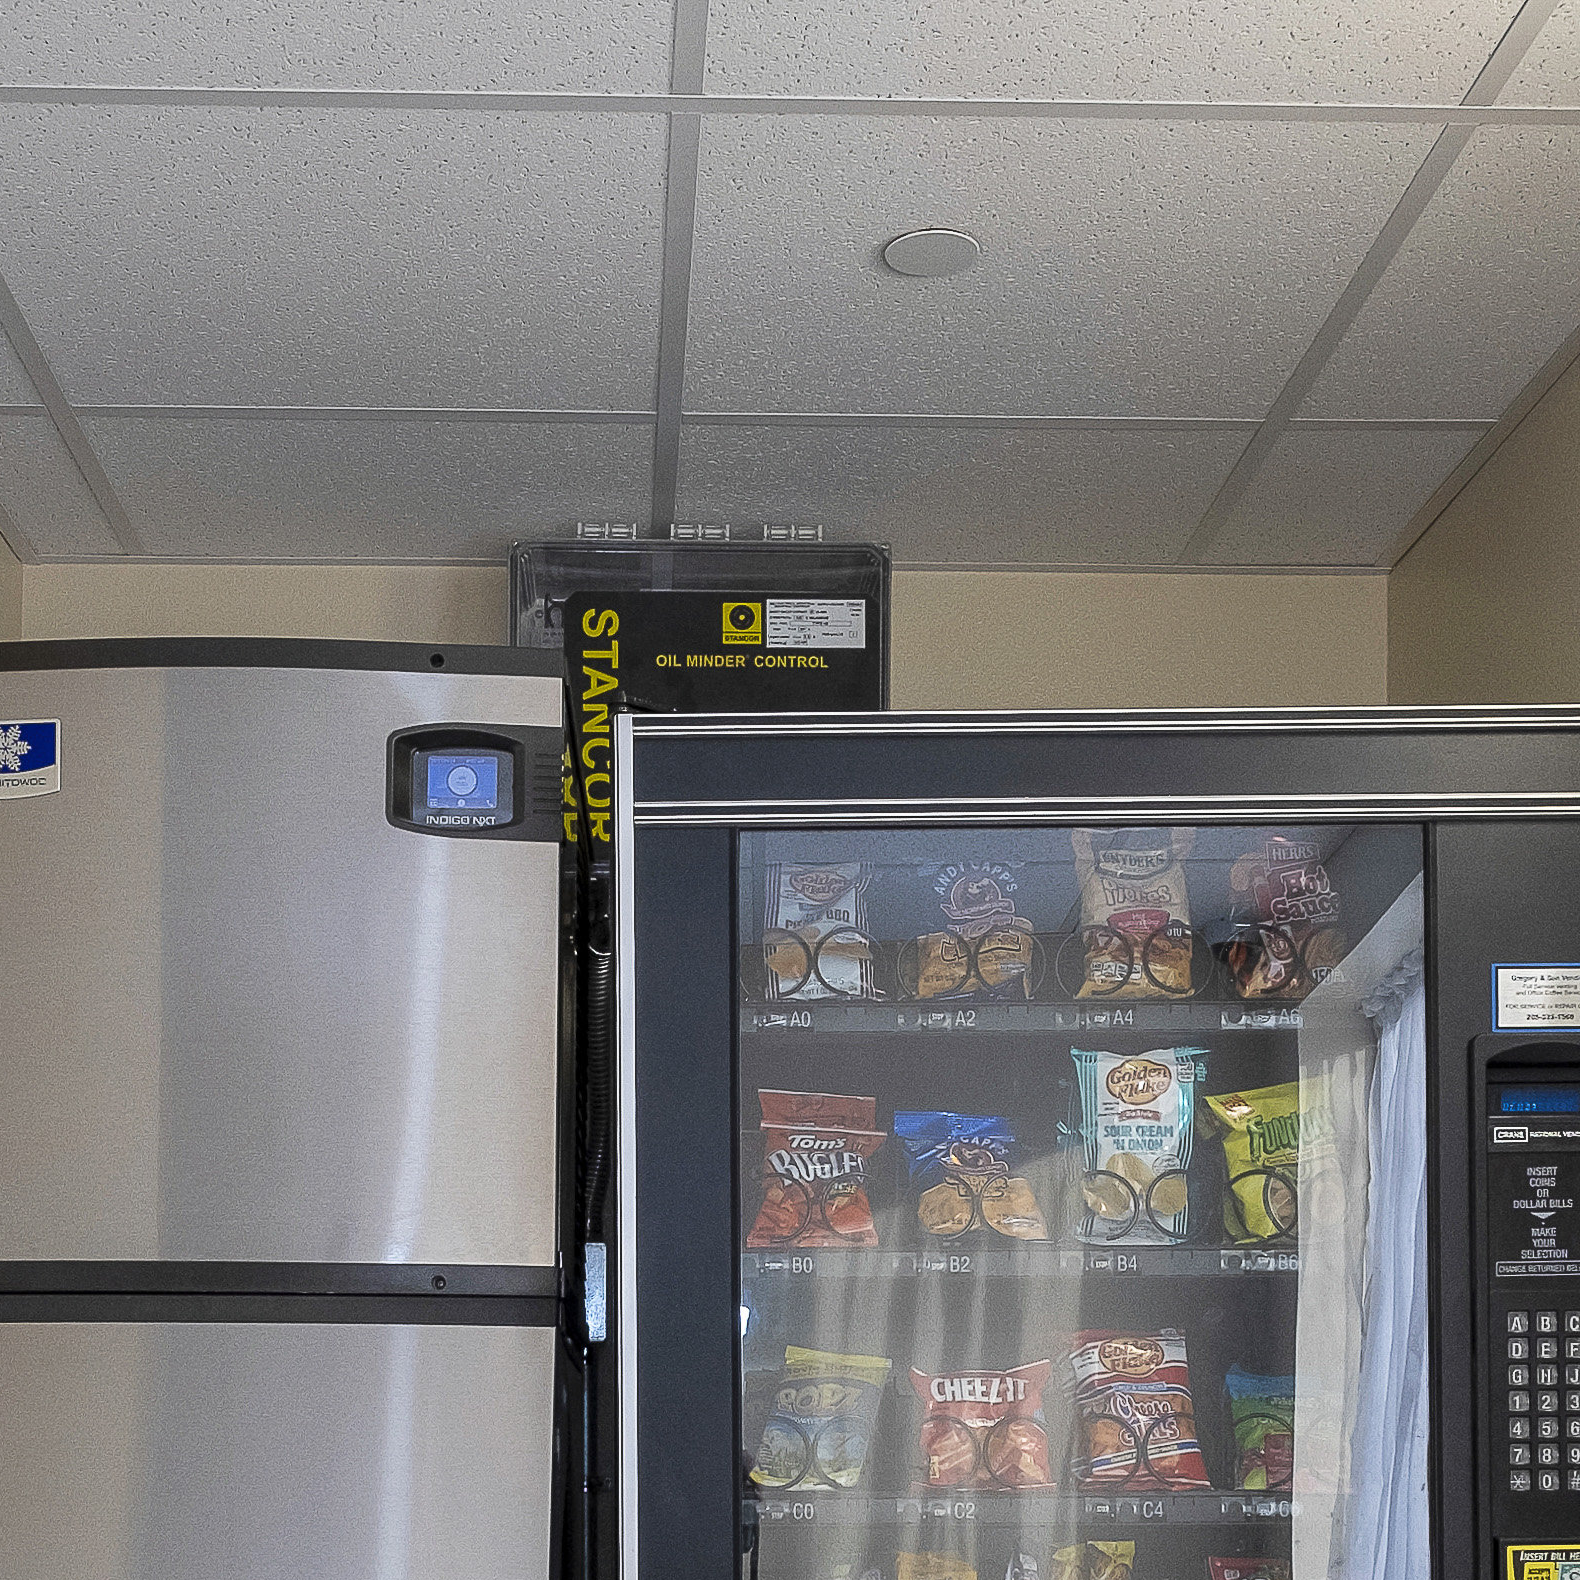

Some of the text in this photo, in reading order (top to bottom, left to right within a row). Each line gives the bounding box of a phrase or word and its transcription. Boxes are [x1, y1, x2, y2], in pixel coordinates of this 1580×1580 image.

[656, 654, 829, 669] OIL MINDER CONTROL
[426, 815, 470, 825] INDIGO
[955, 1010, 976, 1027] A2
[1112, 1009, 1134, 1025] A4
[1110, 1065, 1168, 1085] Golden
[1104, 1125, 1174, 1138] SOUR CREAM
[788, 1134, 847, 1150] Tom's
[1128, 1138, 1164, 1151] ONION
[1526, 1166, 1558, 1176] INSERT
[1529, 1177, 1556, 1187] COINS
[1537, 1188, 1549, 1198] OR
[1513, 1199, 1573, 1208] DOLLAR BILLS
[1531, 1227, 1557, 1236] MAKE
[1532, 1238, 1556, 1247] YOUR
[1521, 1249, 1568, 1259] SELECTION
[950, 1256, 971, 1272] B2
[1117, 1254, 1137, 1272] B4
[1511, 1315, 1580, 1330] A B C
[1512, 1342, 1580, 1357] D E F
[1512, 1369, 1522, 1383] G
[1570, 1369, 1579, 1383] J
[1513, 1395, 1580, 1409] 1 2 3
[1512, 1421, 1580, 1435] 4 5 6
[1513, 1448, 1580, 1462] 7 8 9
[1542, 1475, 1552, 1489] 0
[954, 1502, 976, 1519] C2
[1143, 1501, 1163, 1518] C4
[1520, 1551, 1548, 1561] INSERT
[1550, 1552, 1566, 1560] BILL
